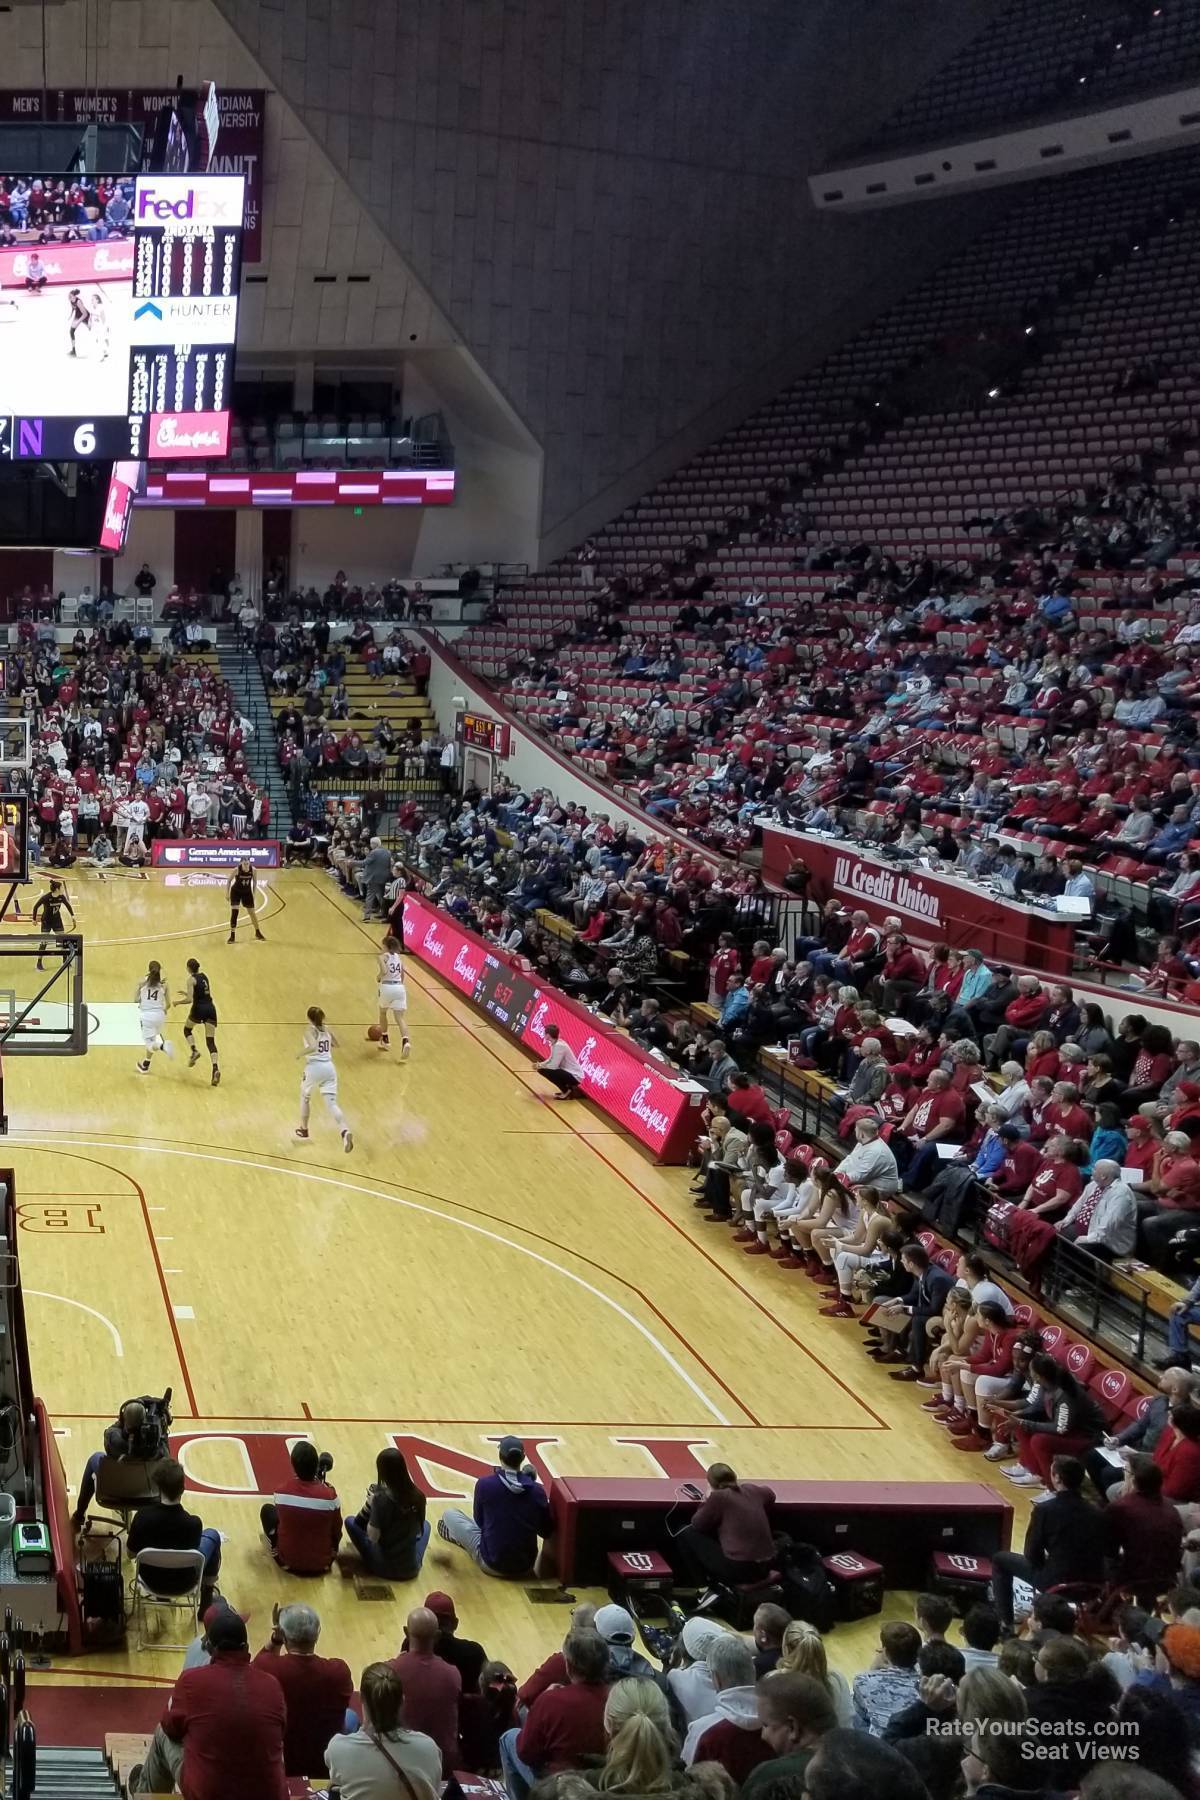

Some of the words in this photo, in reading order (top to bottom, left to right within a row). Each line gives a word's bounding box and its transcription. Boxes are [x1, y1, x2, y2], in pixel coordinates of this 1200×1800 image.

[12, 97, 40, 112] MEN'S
[73, 96, 118, 112] WOMEN'S
[143, 96, 181, 111] WOMEN'
[170, 304, 231, 316] HUNTER
[19, 419, 43, 455] N
[131, 424, 140, 436] 0
[72, 423, 96, 454] 6
[130, 445, 139, 457] 4
[189, 847, 218, 857] German
[218, 847, 251, 856] American
[251, 847, 269, 856] Bank
[834, 856, 850, 886] IU
[851, 863, 895, 900] Credit
[898, 874, 940, 917] Union
[389, 962, 401, 973] 34
[147, 990, 158, 1001] 14
[494, 982, 513, 1006] 6:57
[486, 1000, 495, 1011] 1ST
[494, 1003, 509, 1022] PERIOD
[318, 1040, 329, 1052] 50
[629, 1077, 668, 1136] Chick-fil-A
